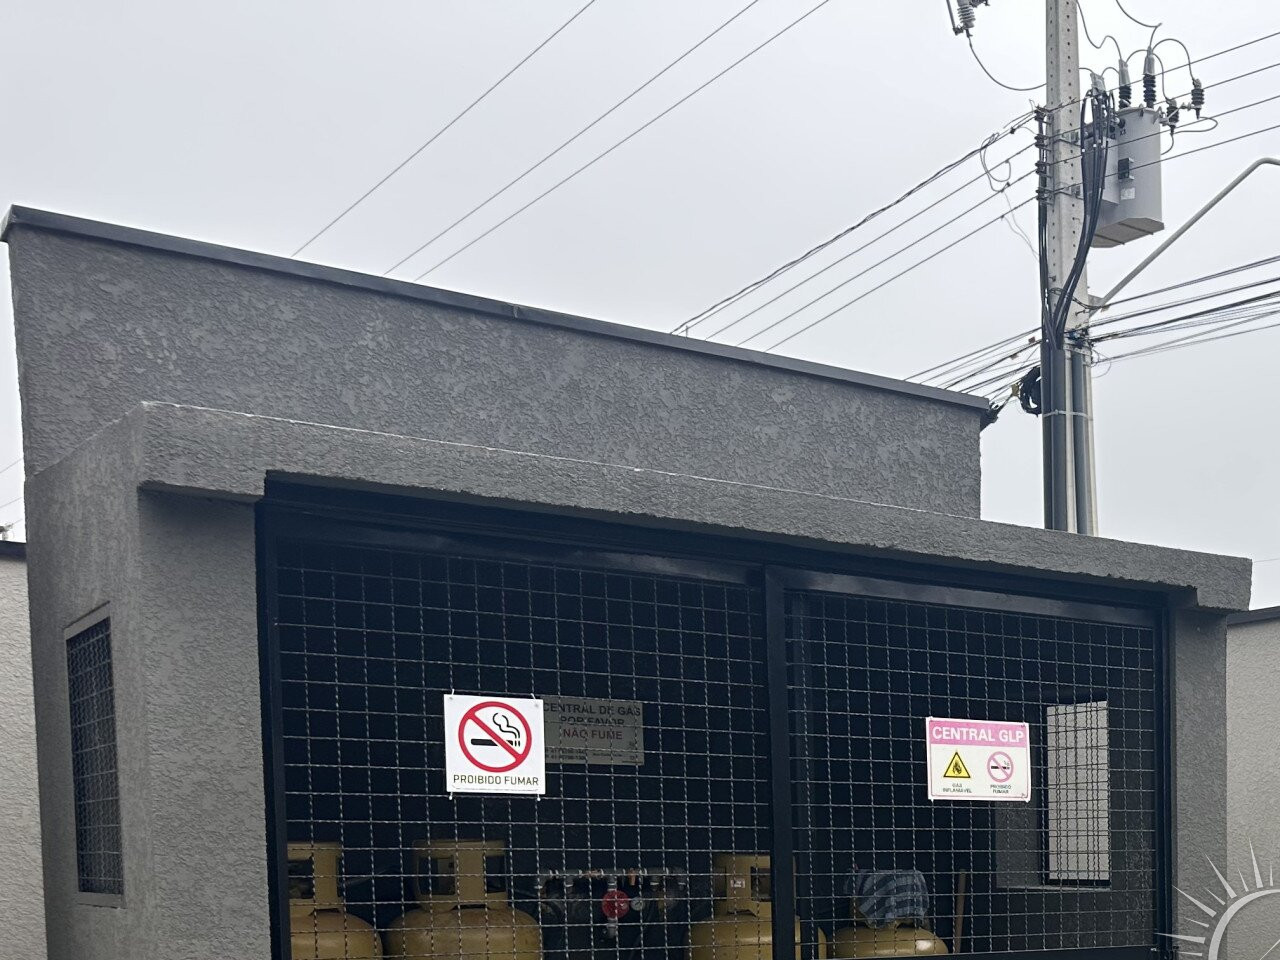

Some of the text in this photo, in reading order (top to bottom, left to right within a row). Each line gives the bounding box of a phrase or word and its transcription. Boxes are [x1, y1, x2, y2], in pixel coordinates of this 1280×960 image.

[600, 705, 614, 715] DE
[591, 729, 623, 740] FUME
[932, 726, 1024, 743] CENTRAL GLP
[453, 774, 539, 786] PROIBIDO FUMAR
